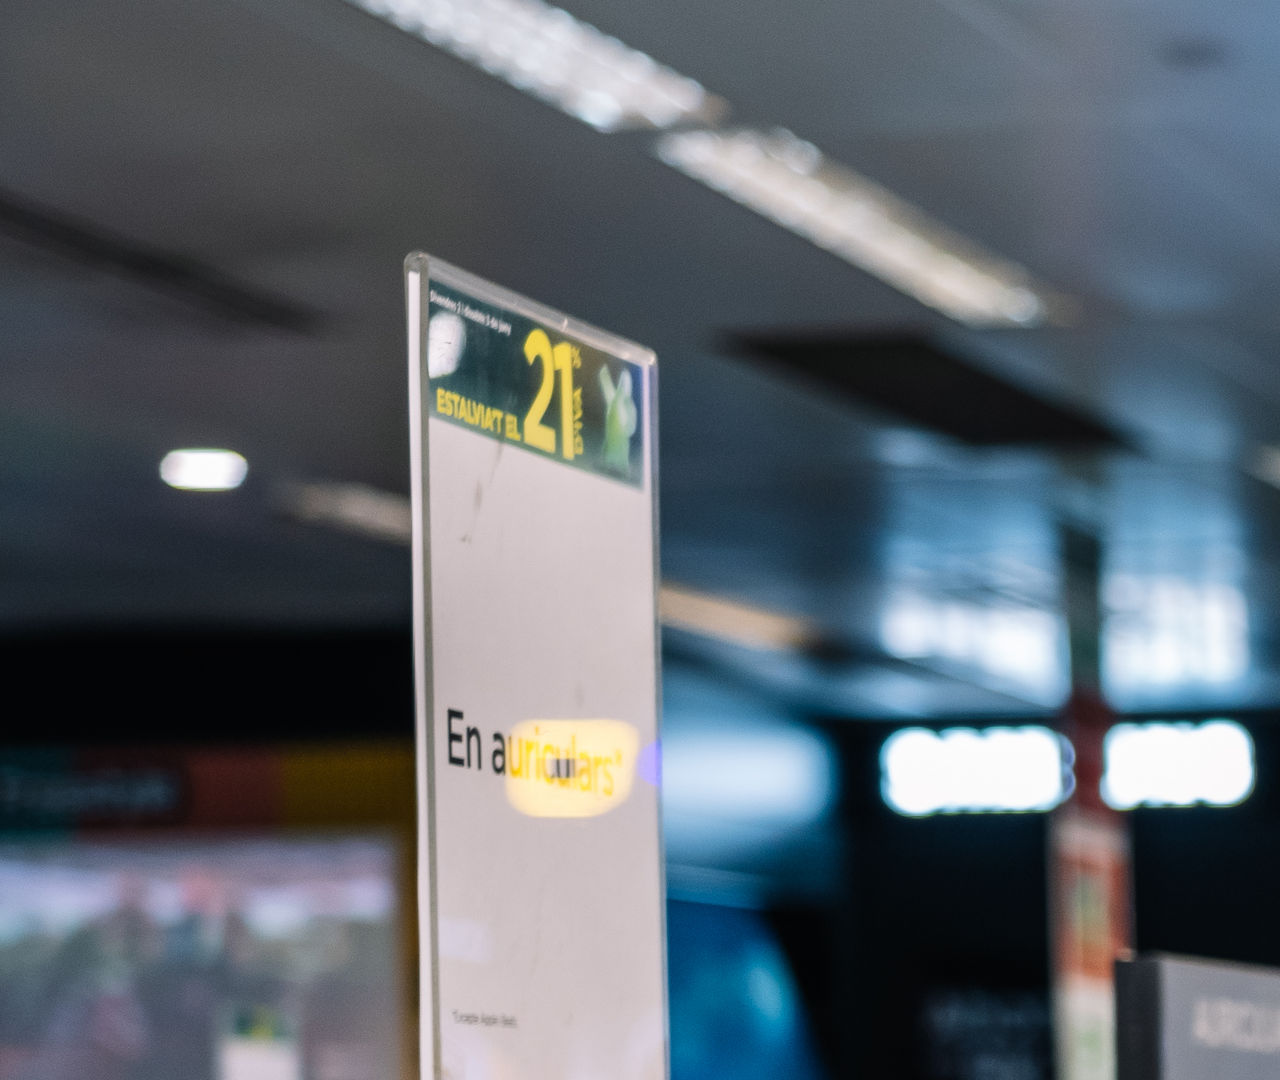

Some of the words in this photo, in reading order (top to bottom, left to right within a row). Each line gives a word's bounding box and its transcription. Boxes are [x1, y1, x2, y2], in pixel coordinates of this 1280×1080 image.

[436, 387, 503, 434] ESTALVIA'T
[505, 413, 521, 441] EL
[447, 708, 482, 771] En
